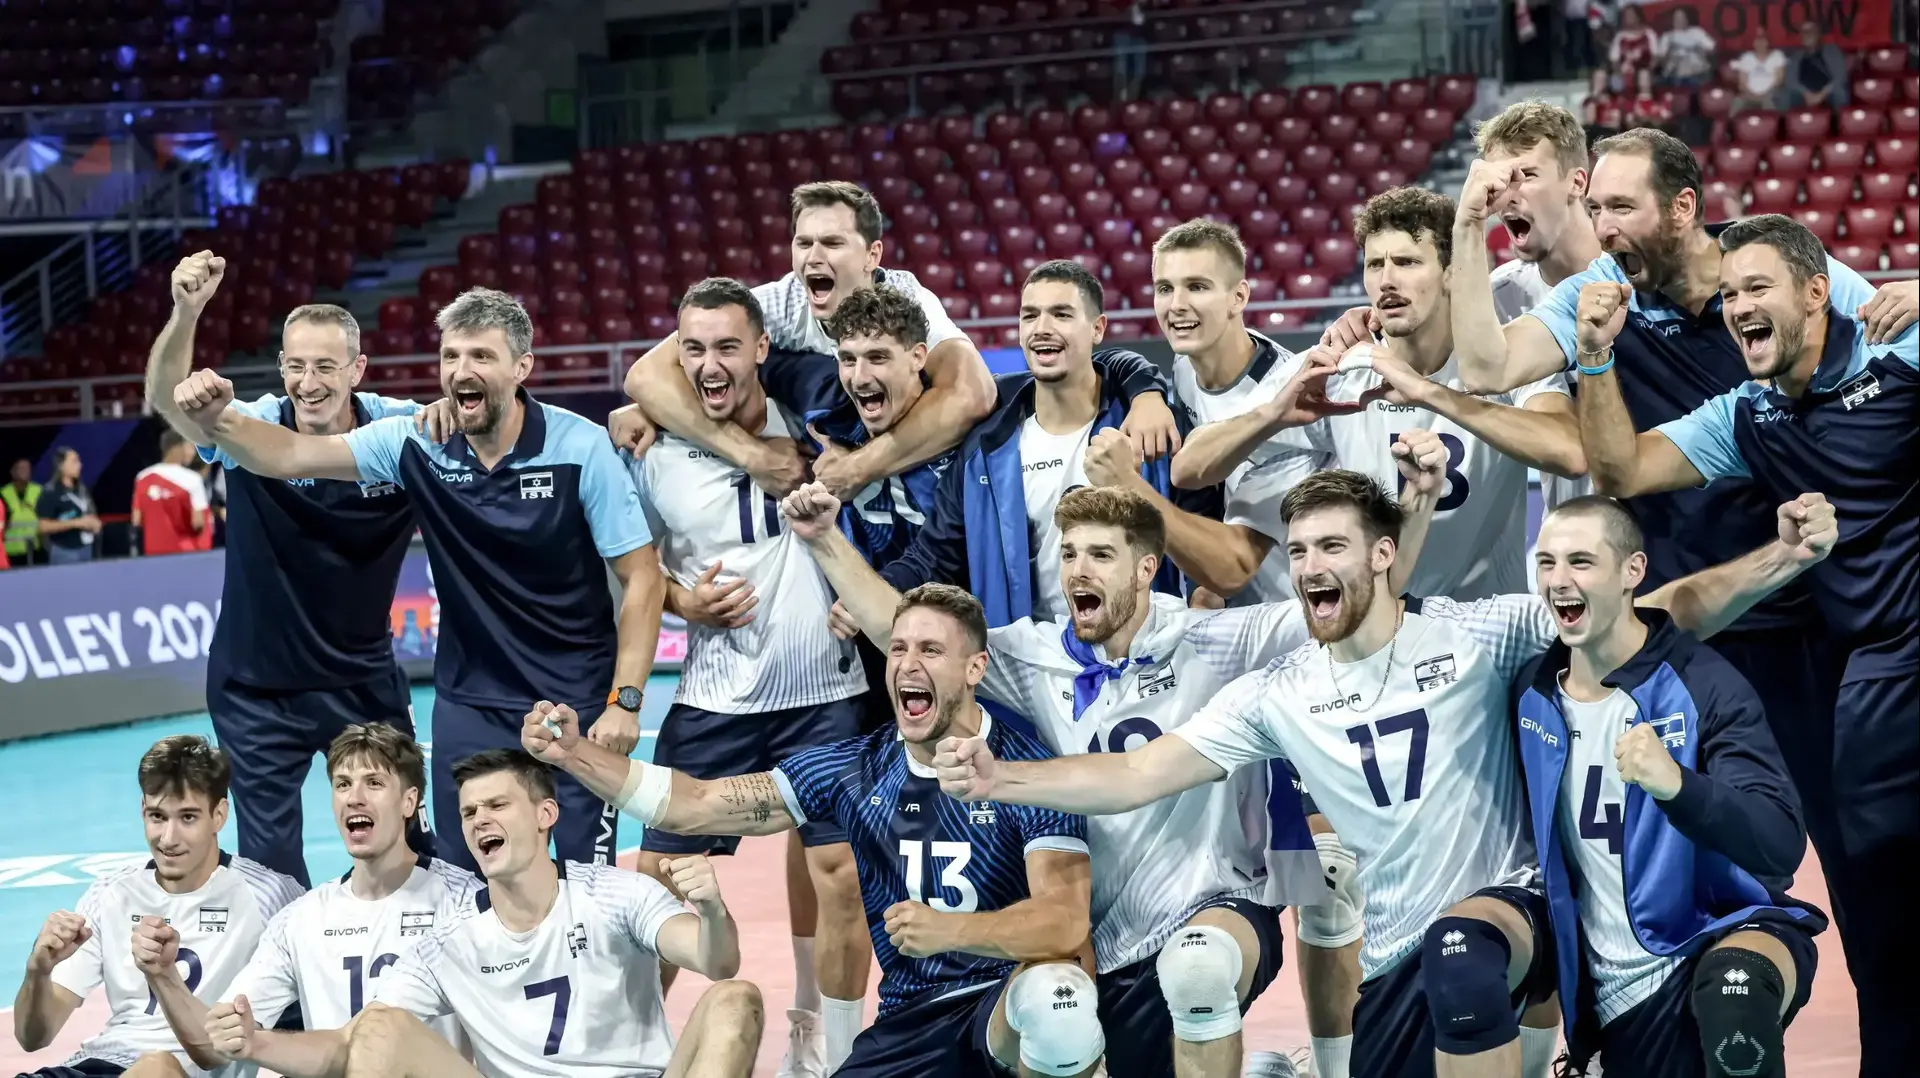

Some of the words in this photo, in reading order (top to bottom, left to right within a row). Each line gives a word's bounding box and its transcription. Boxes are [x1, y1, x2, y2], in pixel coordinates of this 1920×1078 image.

[1843, 387, 1882, 411] ISR
[428, 460, 473, 482] GIVOVA
[521, 491, 554, 500] ISR
[132, 599, 222, 663] 202
[1140, 680, 1178, 700] ISR
[1419, 675, 1459, 693] ISR
[1310, 693, 1362, 714] GIVOVA
[1345, 707, 1430, 807] 17
[1579, 764, 1624, 855] 4
[899, 839, 979, 913] 13
[198, 925, 226, 933] ISR
[324, 926, 369, 937] GIVOVA
[481, 957, 530, 974] GIVOVA
[523, 975, 572, 1057] 7
